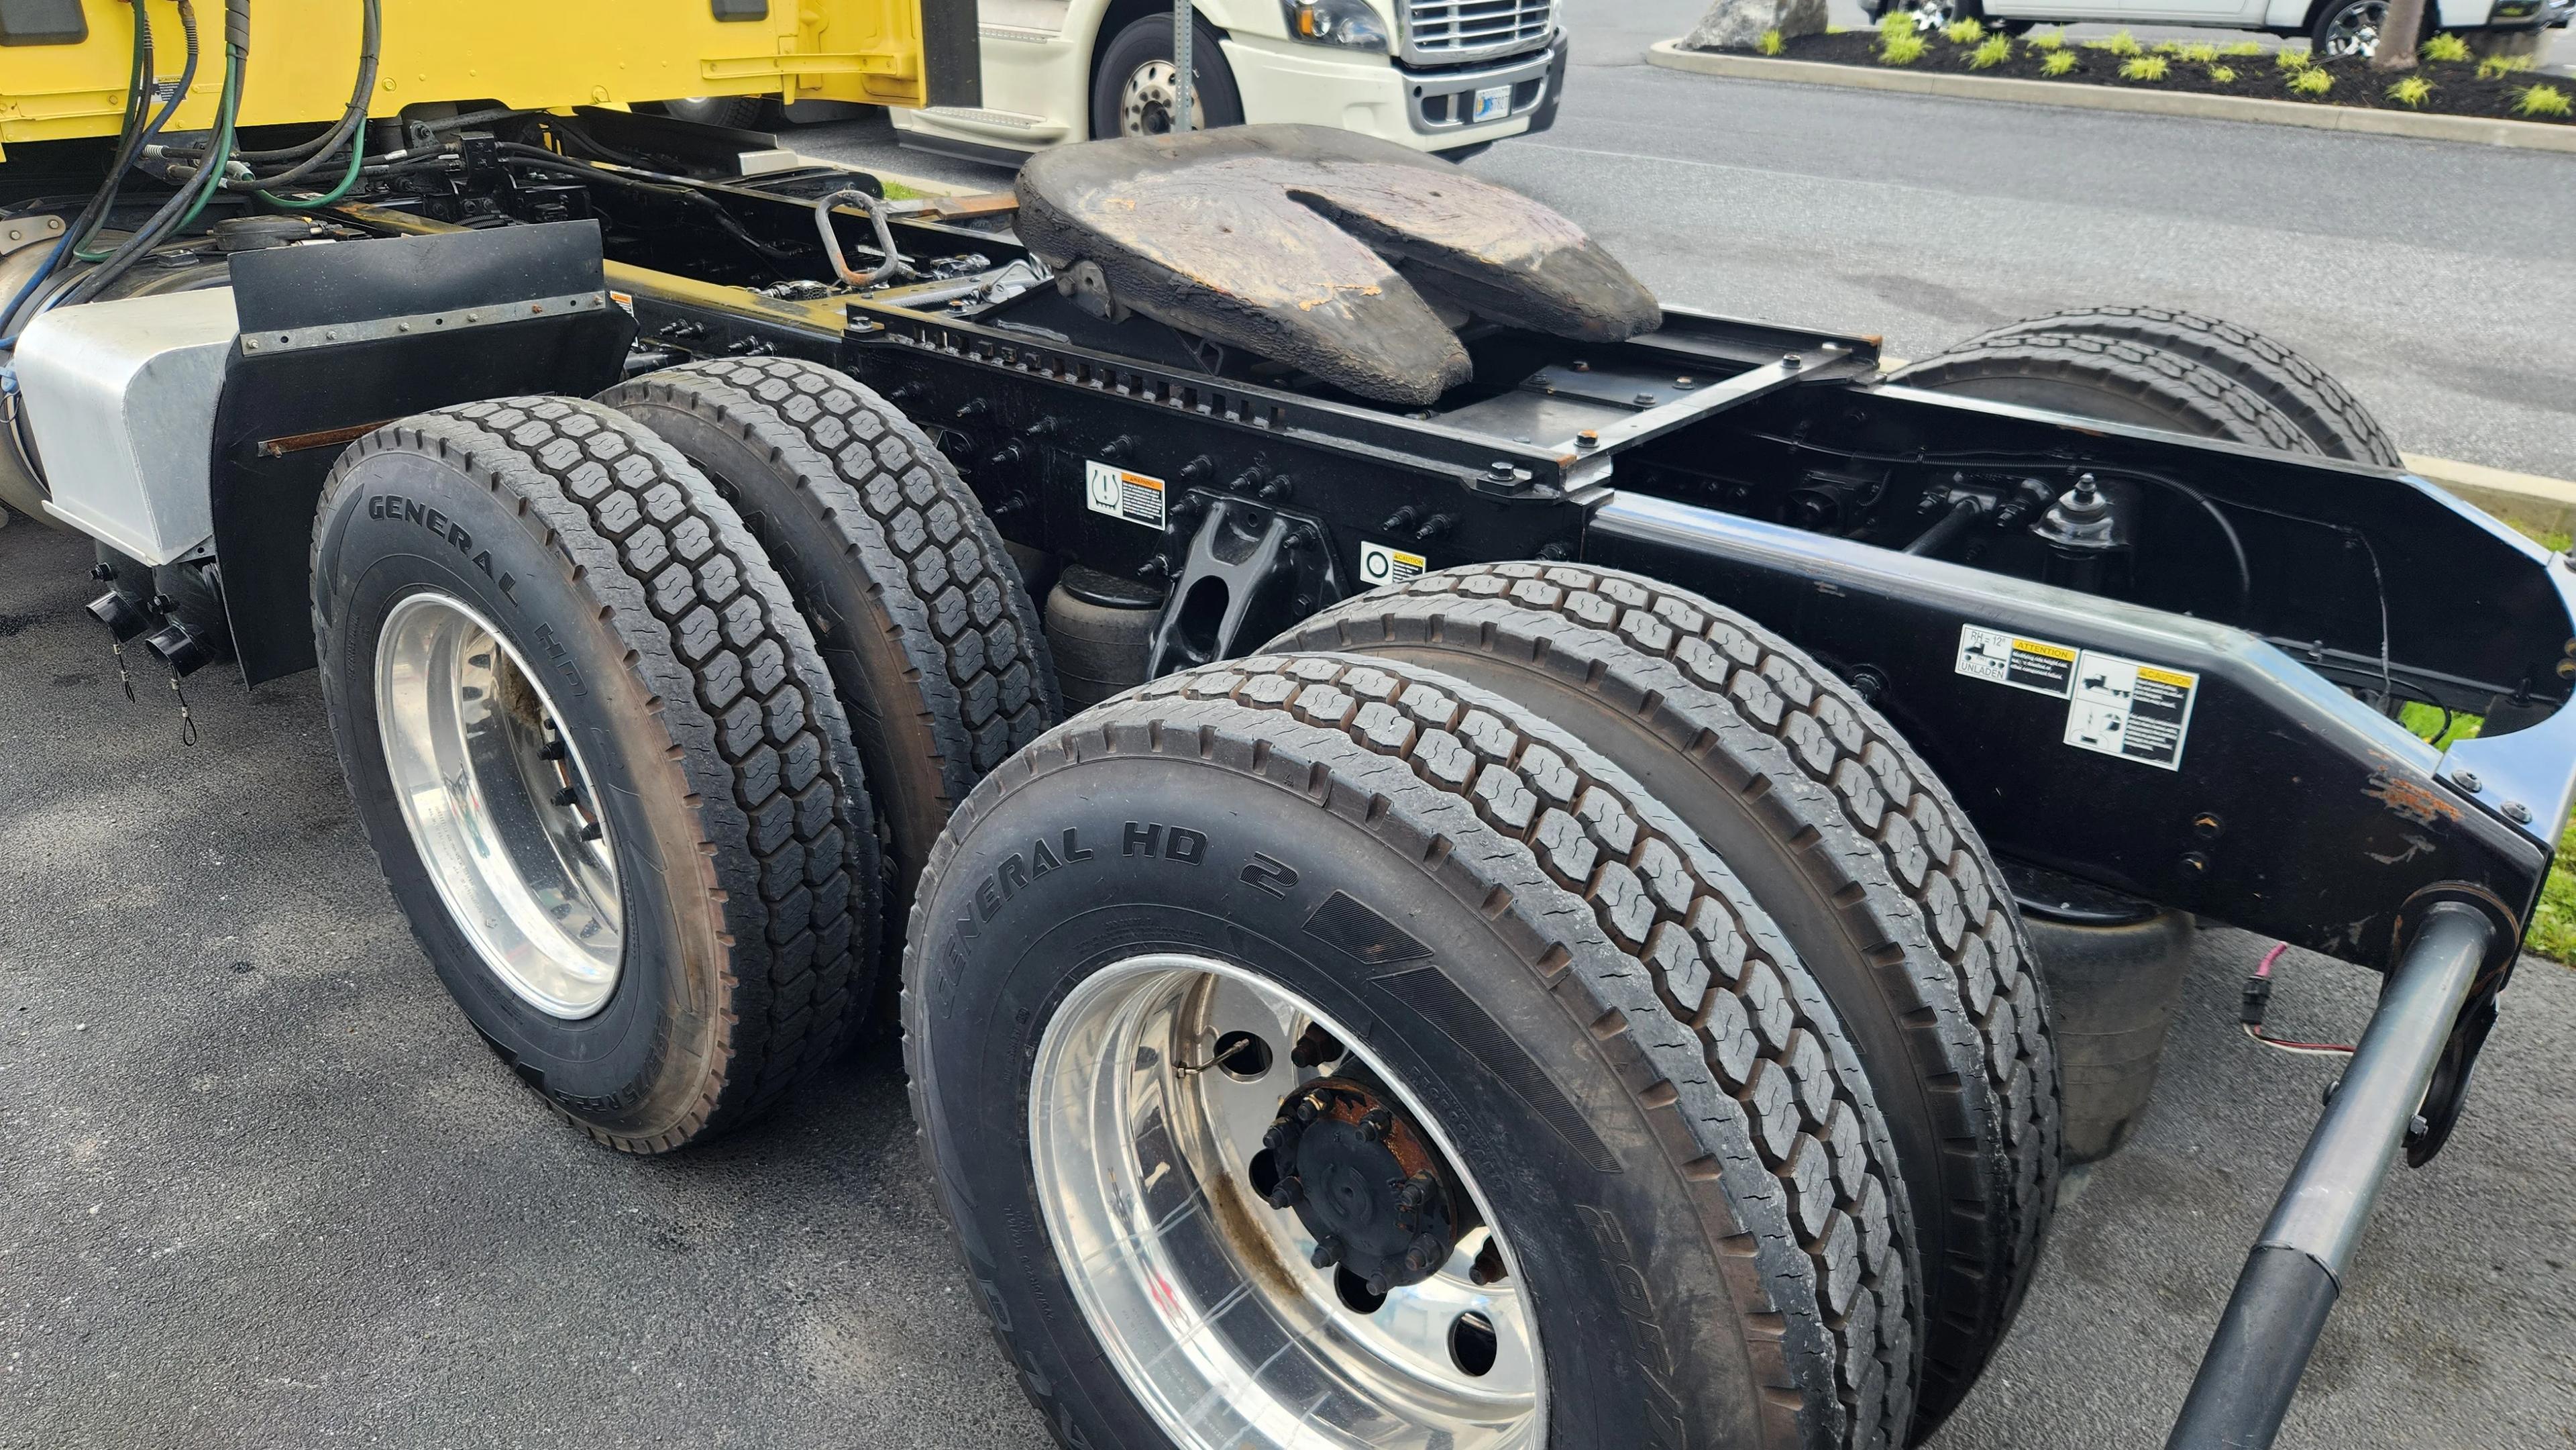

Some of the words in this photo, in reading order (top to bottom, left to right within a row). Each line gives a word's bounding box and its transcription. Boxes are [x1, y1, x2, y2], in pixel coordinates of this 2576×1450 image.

[1399, 555, 1423, 566] CAUTION
[368, 494, 519, 607] GENERAL
[534, 621, 588, 696] HD
[1971, 631, 1983, 641] RH
[2017, 641, 2069, 658] ATTENTION
[1961, 662, 2004, 680] UNLADEN
[2147, 671, 2191, 685] CAUTION
[1122, 820, 1210, 866] HD
[1239, 851, 1299, 900] 2
